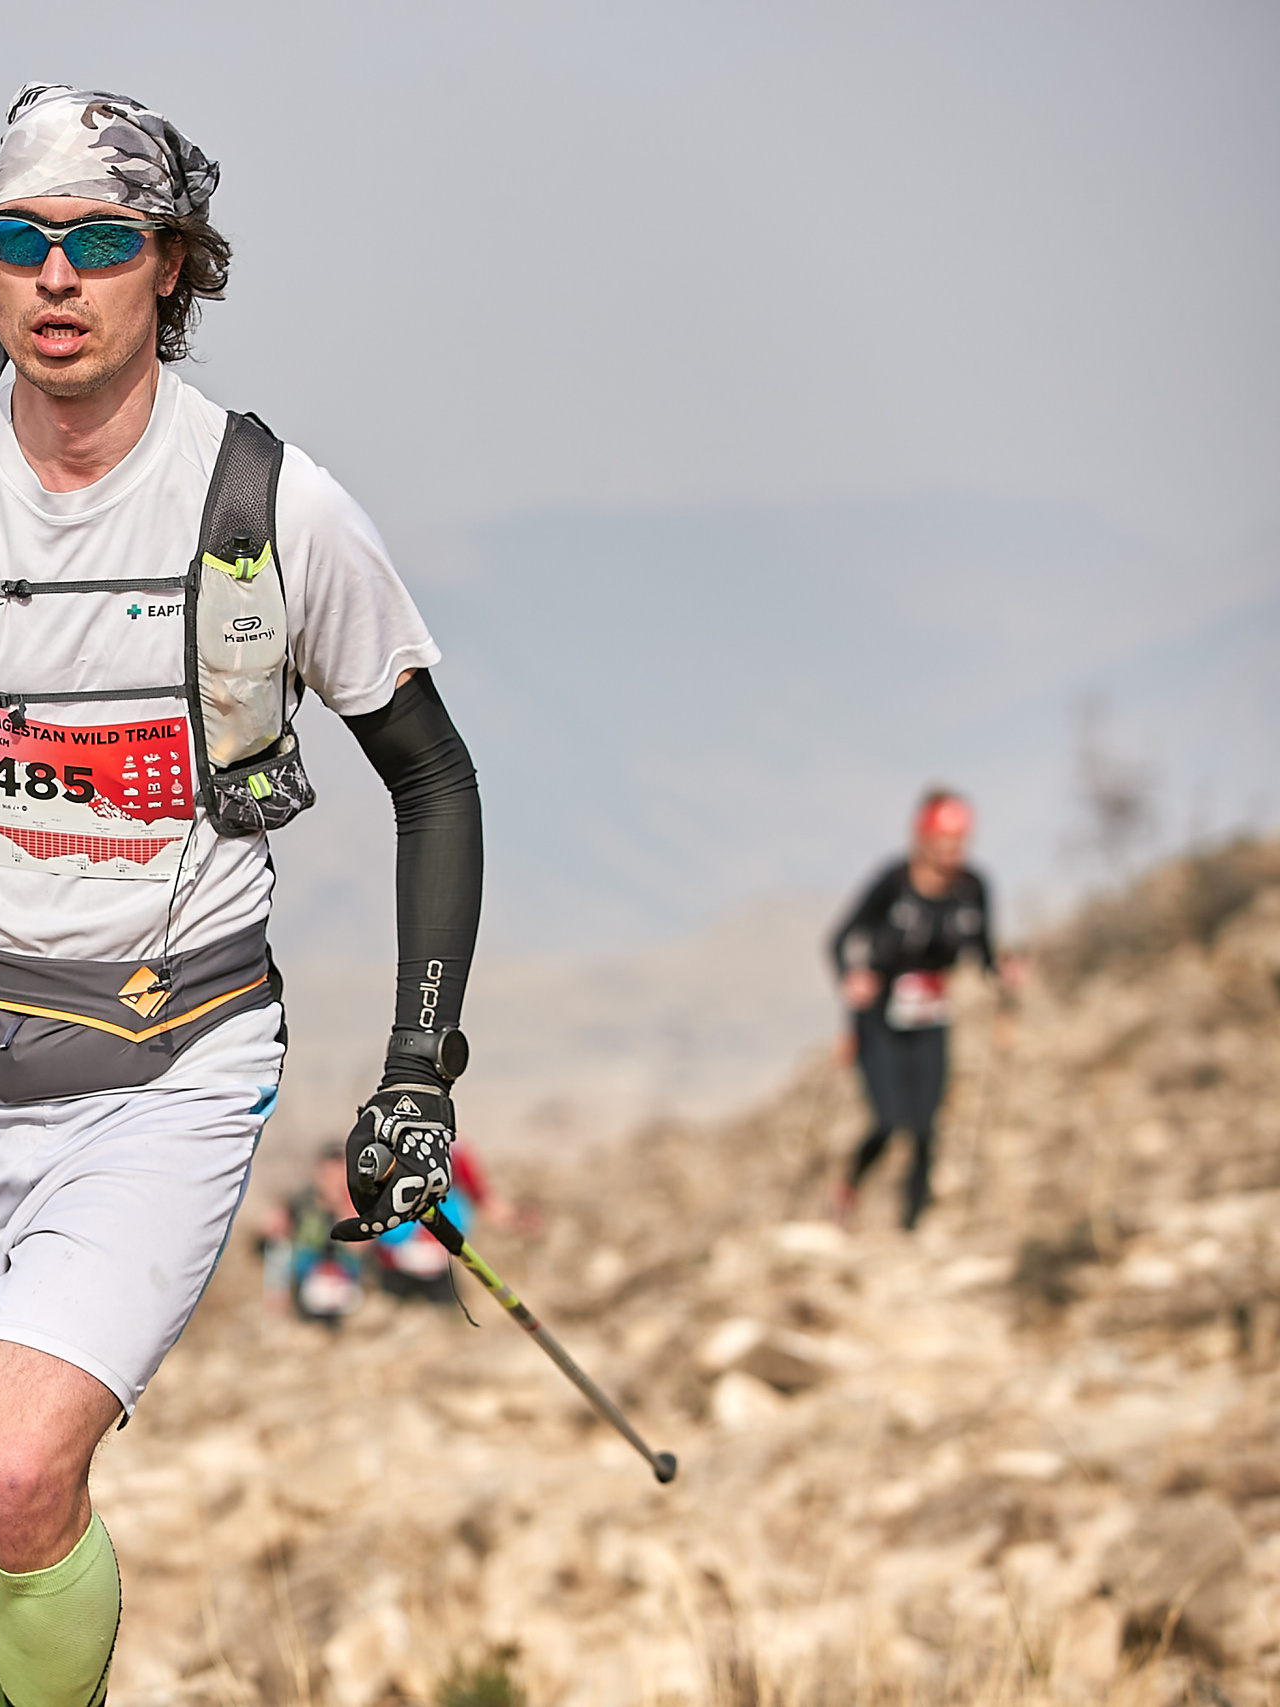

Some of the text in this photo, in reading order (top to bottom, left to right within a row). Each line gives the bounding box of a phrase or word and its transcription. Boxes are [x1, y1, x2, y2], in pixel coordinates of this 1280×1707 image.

[148, 604, 185, 617] EAPT
[224, 627, 276, 643] Kalenji
[71, 730, 120, 746] WILD
[125, 724, 177, 742] TRAIL
[419, 959, 443, 1028] odlo
